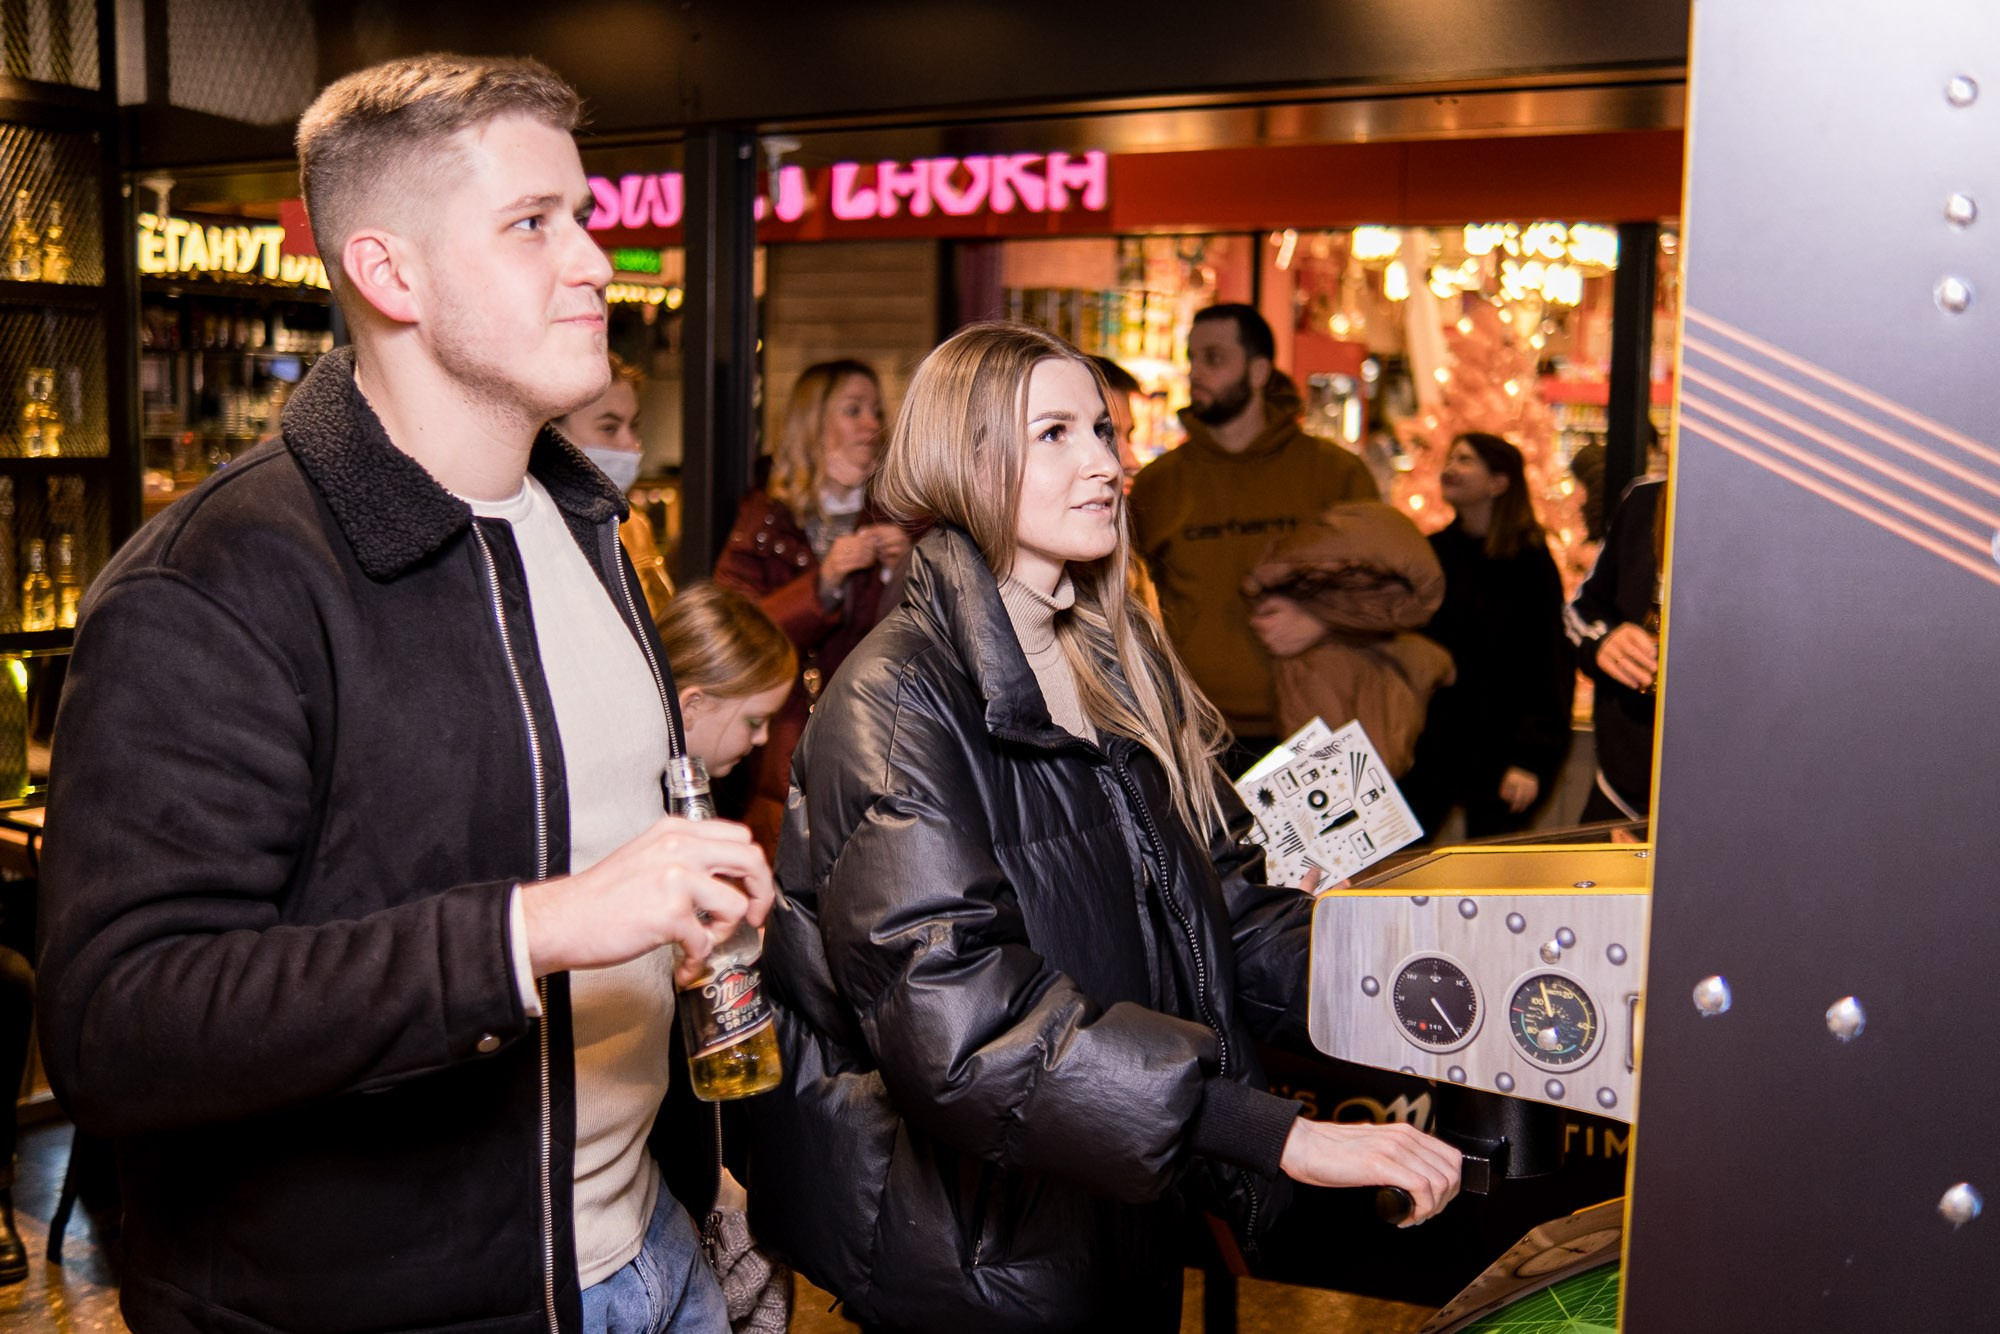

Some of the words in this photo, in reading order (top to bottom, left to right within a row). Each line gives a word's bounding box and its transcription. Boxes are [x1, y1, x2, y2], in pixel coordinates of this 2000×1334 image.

[702, 970, 761, 1014] Miller
[716, 996, 762, 1024] GENUINE
[724, 1008, 760, 1032] DRAFT
